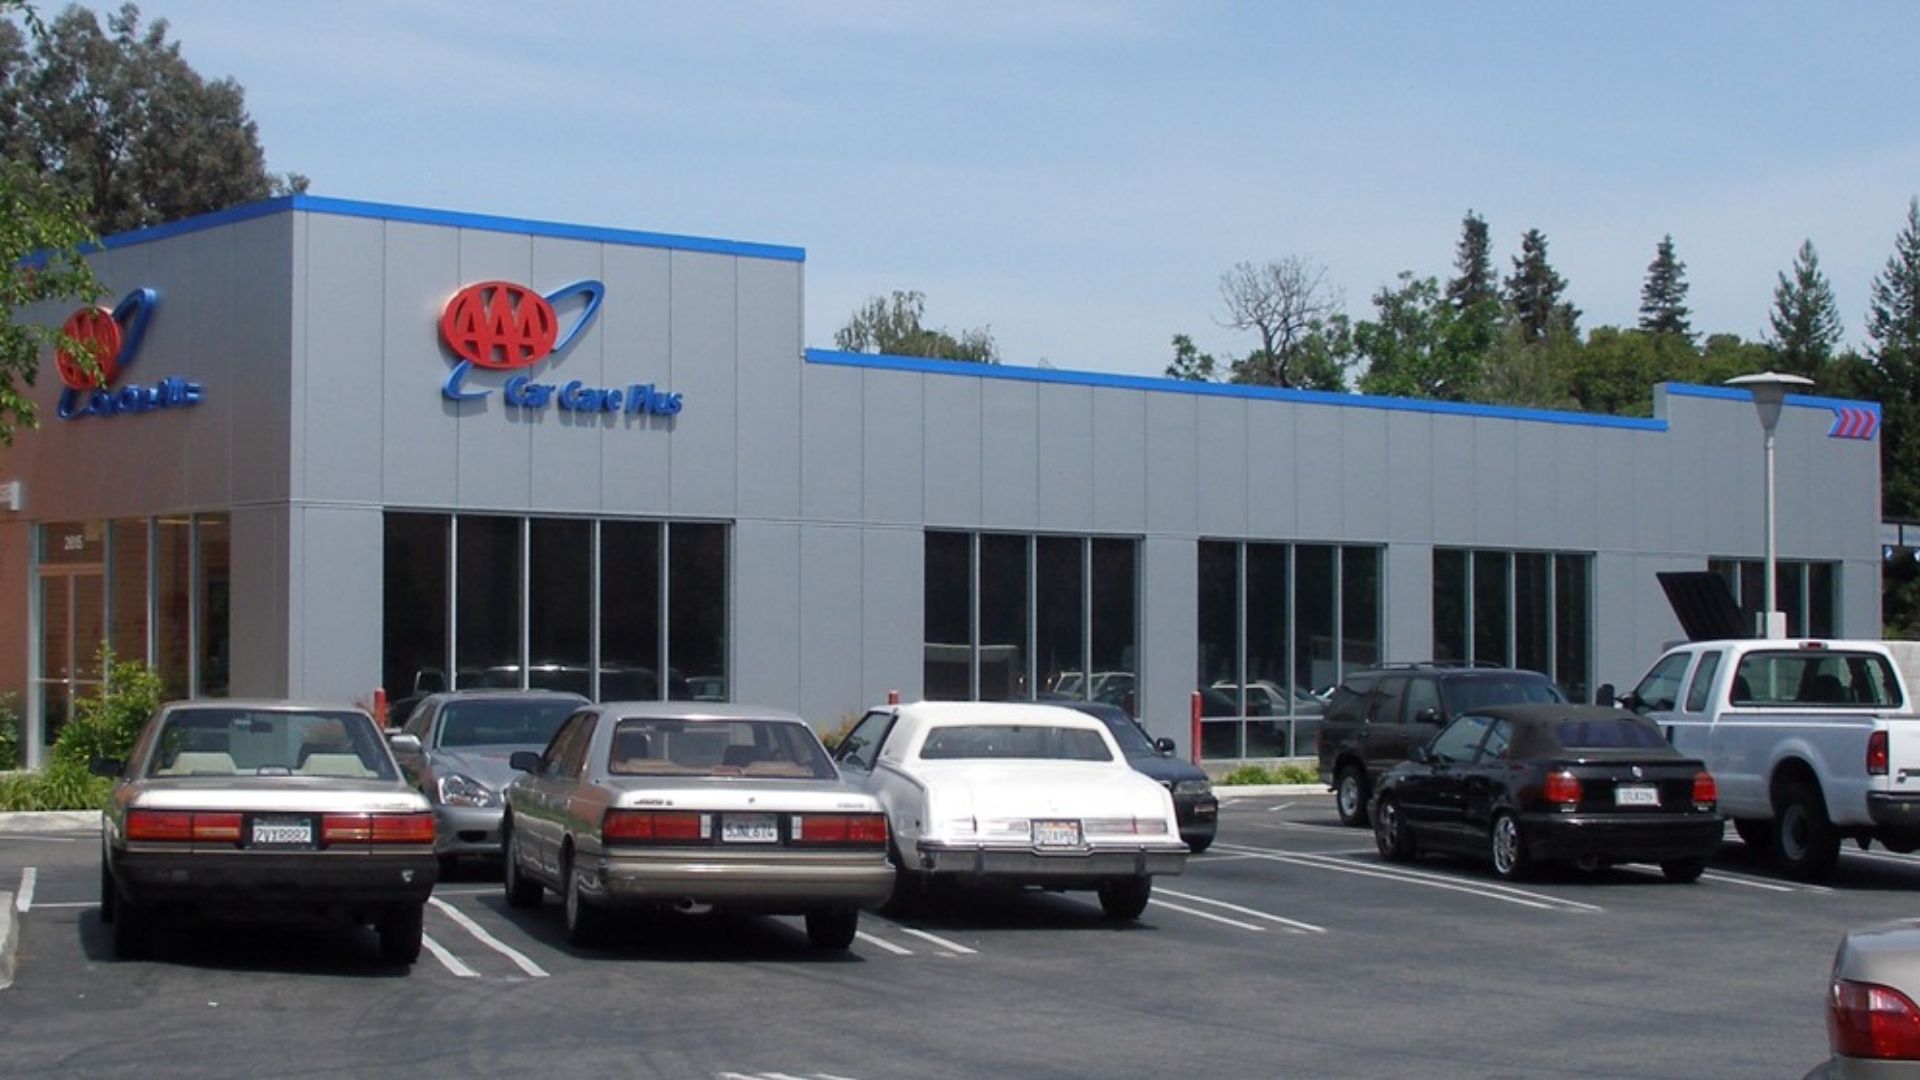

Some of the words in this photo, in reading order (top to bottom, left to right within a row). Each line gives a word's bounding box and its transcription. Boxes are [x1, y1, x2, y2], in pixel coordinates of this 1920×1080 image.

[449, 283, 552, 366] AAA
[504, 375, 556, 408] Car
[558, 380, 623, 412] Care
[624, 383, 683, 416] Plus
